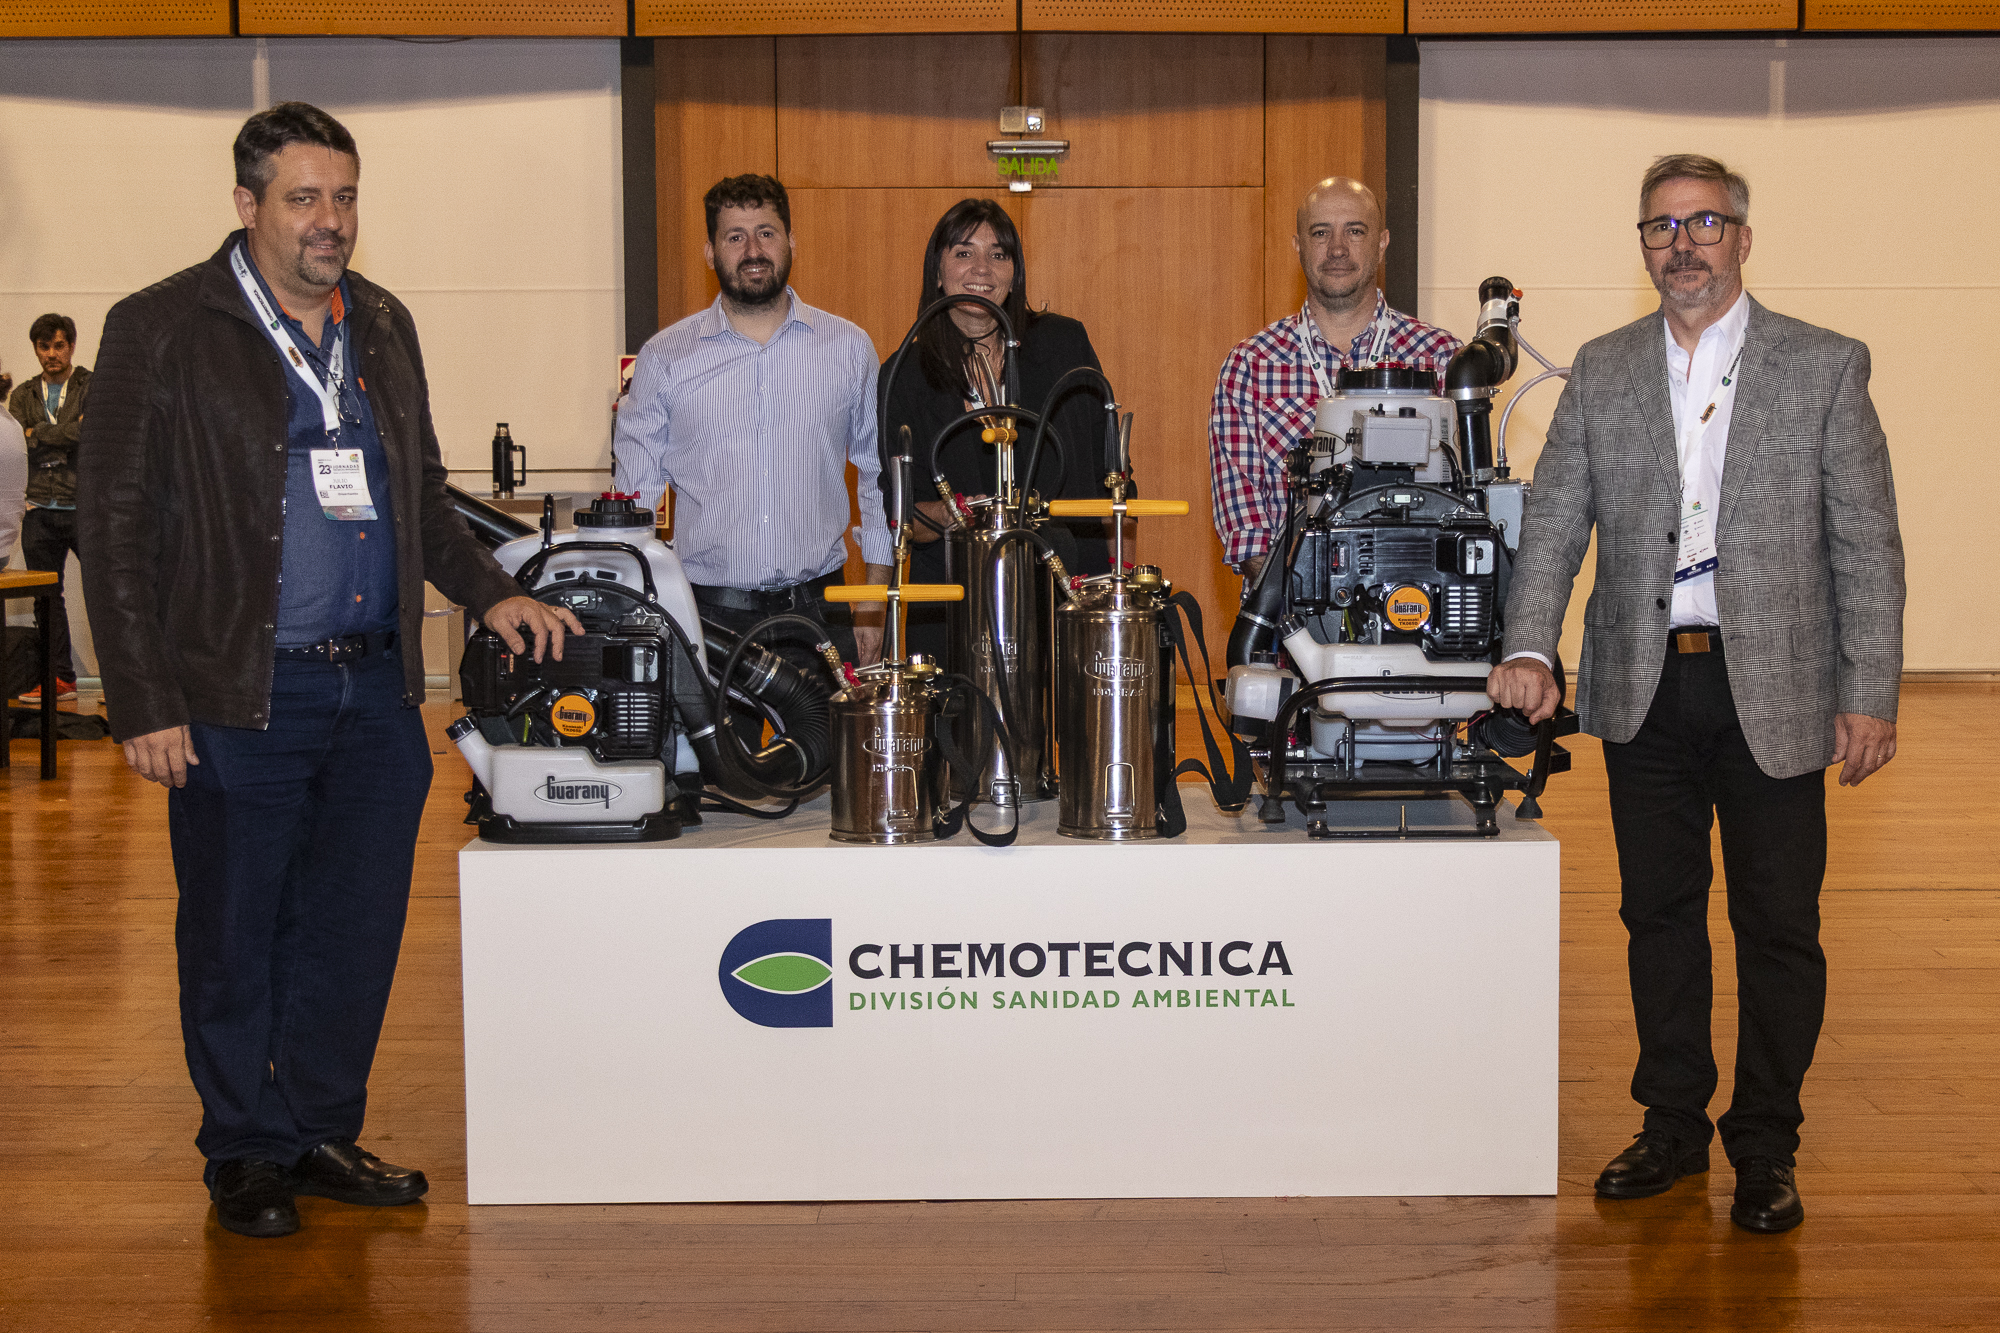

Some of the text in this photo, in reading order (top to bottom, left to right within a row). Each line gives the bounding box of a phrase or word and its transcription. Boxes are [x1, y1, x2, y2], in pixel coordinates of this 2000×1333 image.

[998, 157, 1058, 175] SALIDA
[1394, 600, 1422, 618] Guarany
[560, 705, 587, 727] Guarany
[547, 775, 609, 809] Guarany
[849, 940, 1294, 980] CHEMOTECNICA
[849, 986, 1296, 1011] DIVISIÓN SANIDAD AMBIENTAL
